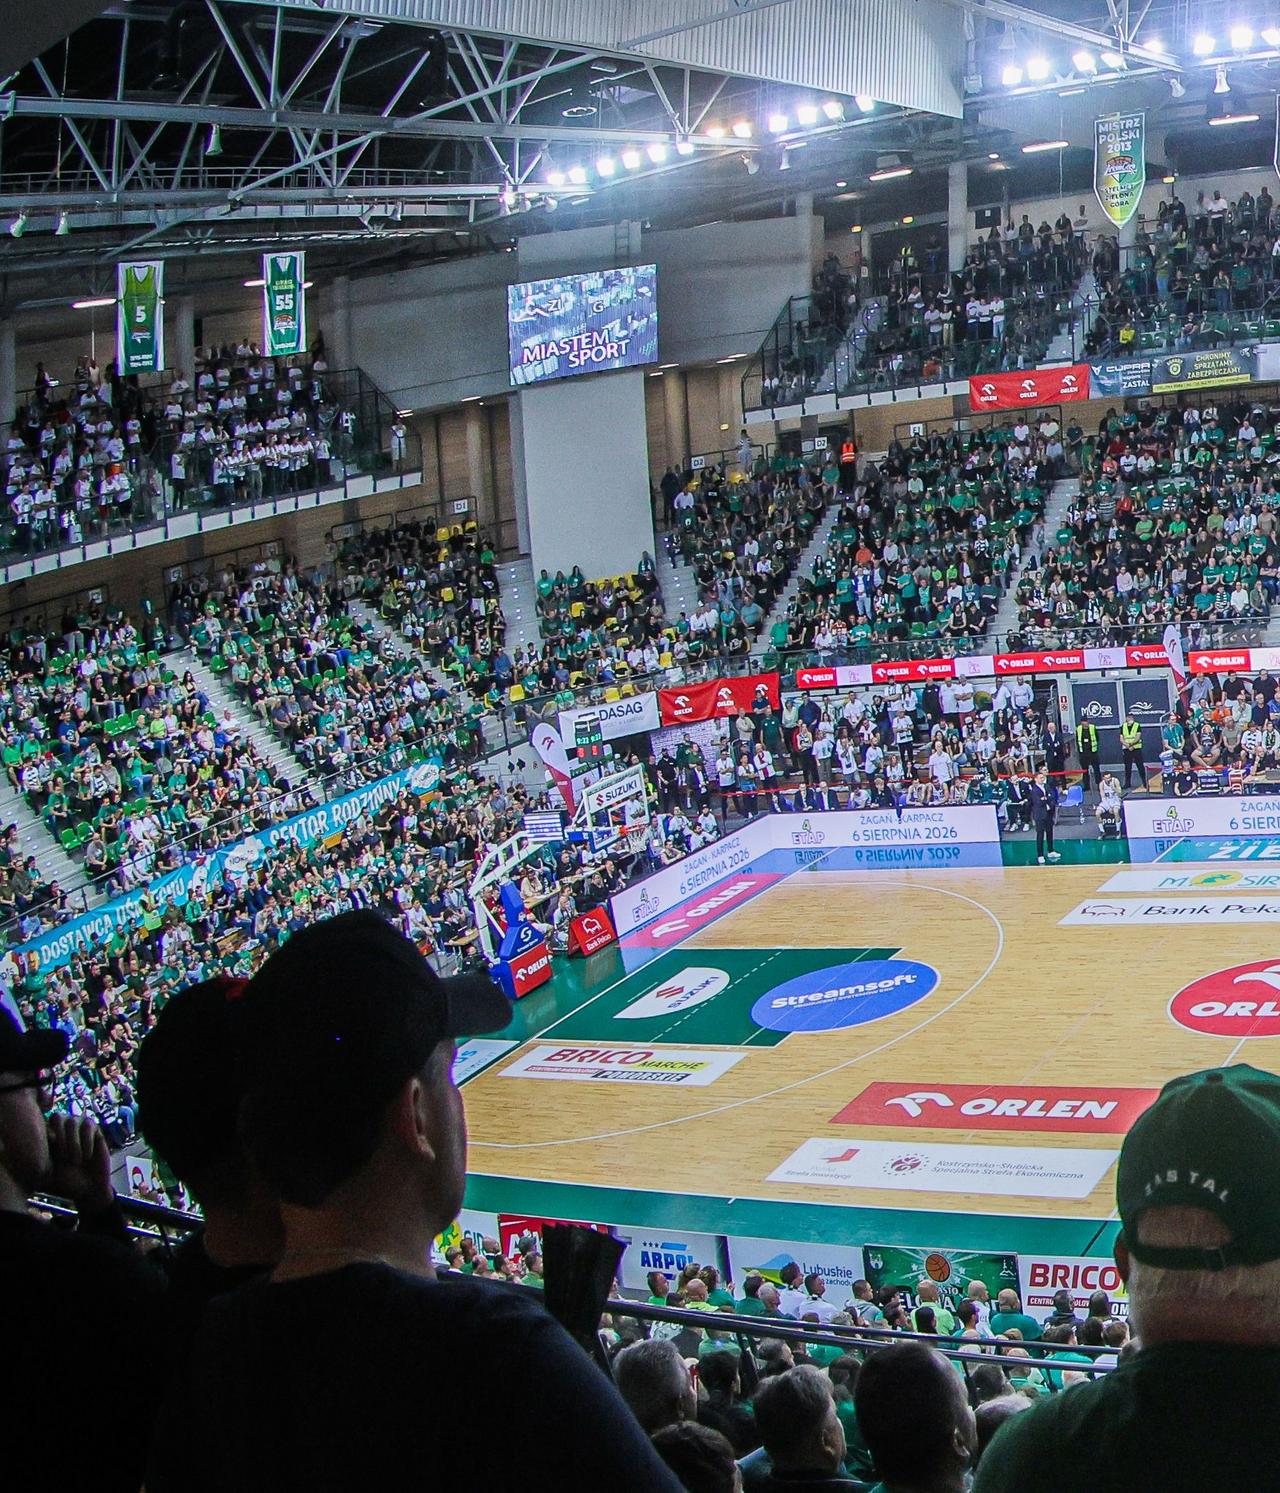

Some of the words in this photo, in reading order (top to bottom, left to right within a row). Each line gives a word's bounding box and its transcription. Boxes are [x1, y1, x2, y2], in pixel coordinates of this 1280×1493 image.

[1099, 118, 1141, 133] MISTRZ
[1099, 130, 1140, 145] POLSKI
[1107, 143, 1132, 154] 2013
[275, 293, 294, 311] 55
[135, 305, 146, 323] 5
[523, 329, 610, 364] MIASTEM
[568, 339, 630, 368] SPORT
[1195, 351, 1231, 361] CHRONIMY
[1106, 363, 1151, 373] CUPRA
[1187, 367, 1241, 379] ZABEZPIECZAMY
[1122, 379, 1151, 388] ZASTAL
[1010, 658, 1034, 668] ORLEN
[1056, 655, 1080, 665] ORLEN
[1213, 656, 1245, 666] ORLEN
[887, 667, 909, 677] ORLEN
[928, 664, 951, 674] ORLEN
[813, 673, 834, 683] ORLEN
[599, 701, 643, 721] DASAG
[605, 780, 637, 802] SUZUKI
[269, 810, 330, 846] SEKTOR
[332, 776, 401, 826] RODZINNY
[1240, 799, 1280, 812] ŻAGAŃ
[859, 813, 892, 825] ŻAGAŃ
[1152, 817, 1195, 833] ETAP
[791, 831, 825, 845] ETAP
[862, 827, 923, 842] SIERPNIA
[925, 826, 958, 840] 2026
[711, 837, 741, 863] KARPACZ
[687, 860, 728, 892] SIERPNIA
[728, 849, 750, 871] 2026
[687, 880, 757, 918] ORLEN
[632, 897, 660, 923] ETAP
[1143, 904, 1216, 916] Bank
[40, 913, 113, 964] DOSTAWCA
[527, 955, 548, 975] ORLEN
[667, 976, 720, 1009] SUZUKI
[771, 974, 917, 1009] Streamsoft
[543, 1049, 654, 1065] BRICO
[641, 1060, 704, 1070] MARCHE
[602, 1070, 688, 1082] POMORSKIE
[959, 1099, 1119, 1119] ORLEN
[1015, 1170, 1084, 1179] Ekonomiczna
[803, 1262, 853, 1280] Lubuskie
[1029, 1263, 1121, 1292] BRICO
